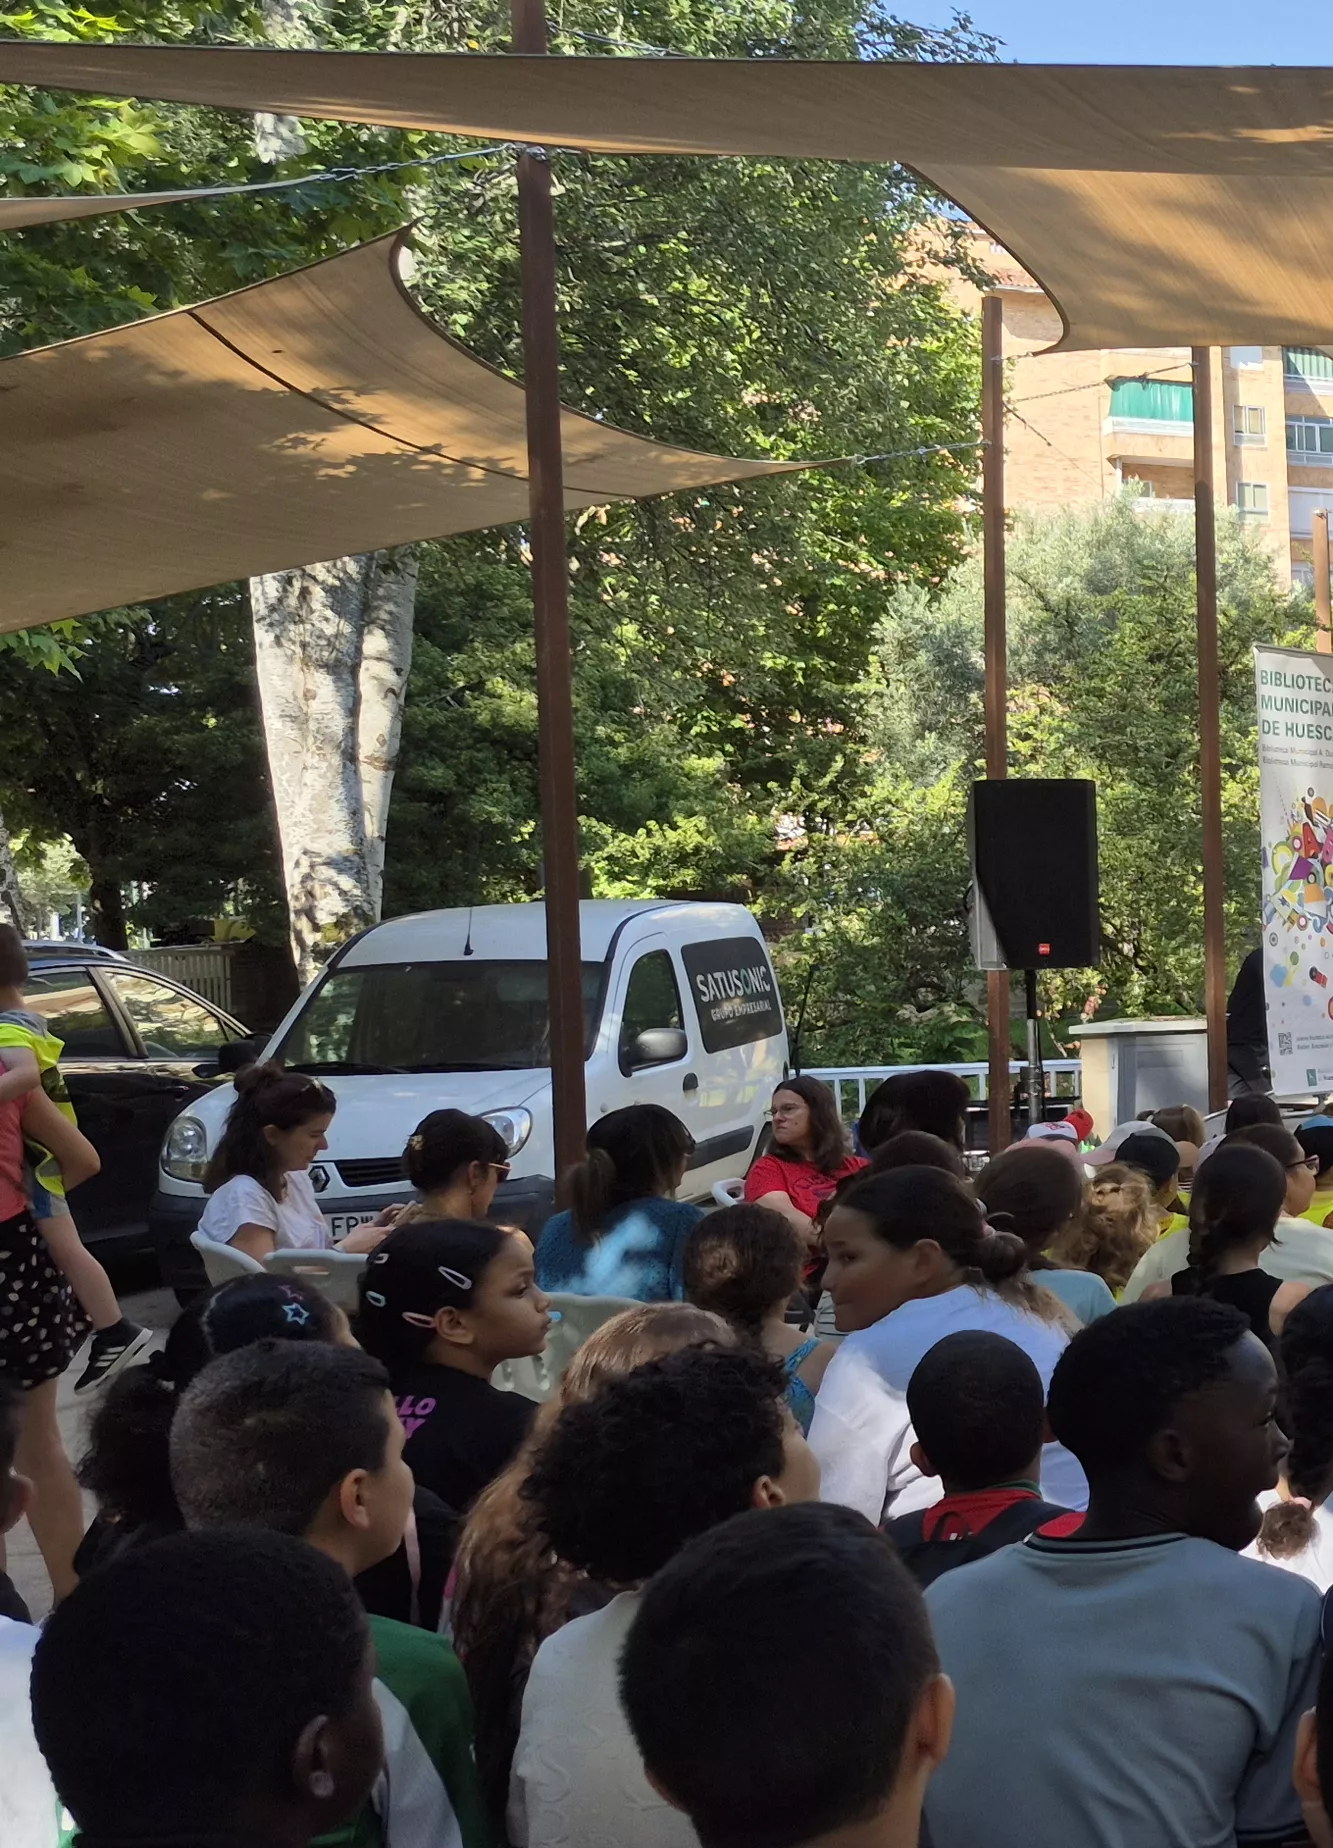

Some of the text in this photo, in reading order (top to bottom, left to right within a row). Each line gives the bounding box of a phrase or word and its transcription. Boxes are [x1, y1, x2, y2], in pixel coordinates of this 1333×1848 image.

[1262, 719, 1281, 736] DE
[696, 965, 771, 1003] SATUSONIC
[711, 999, 772, 1021] GRUPO EMPRESARIAL
